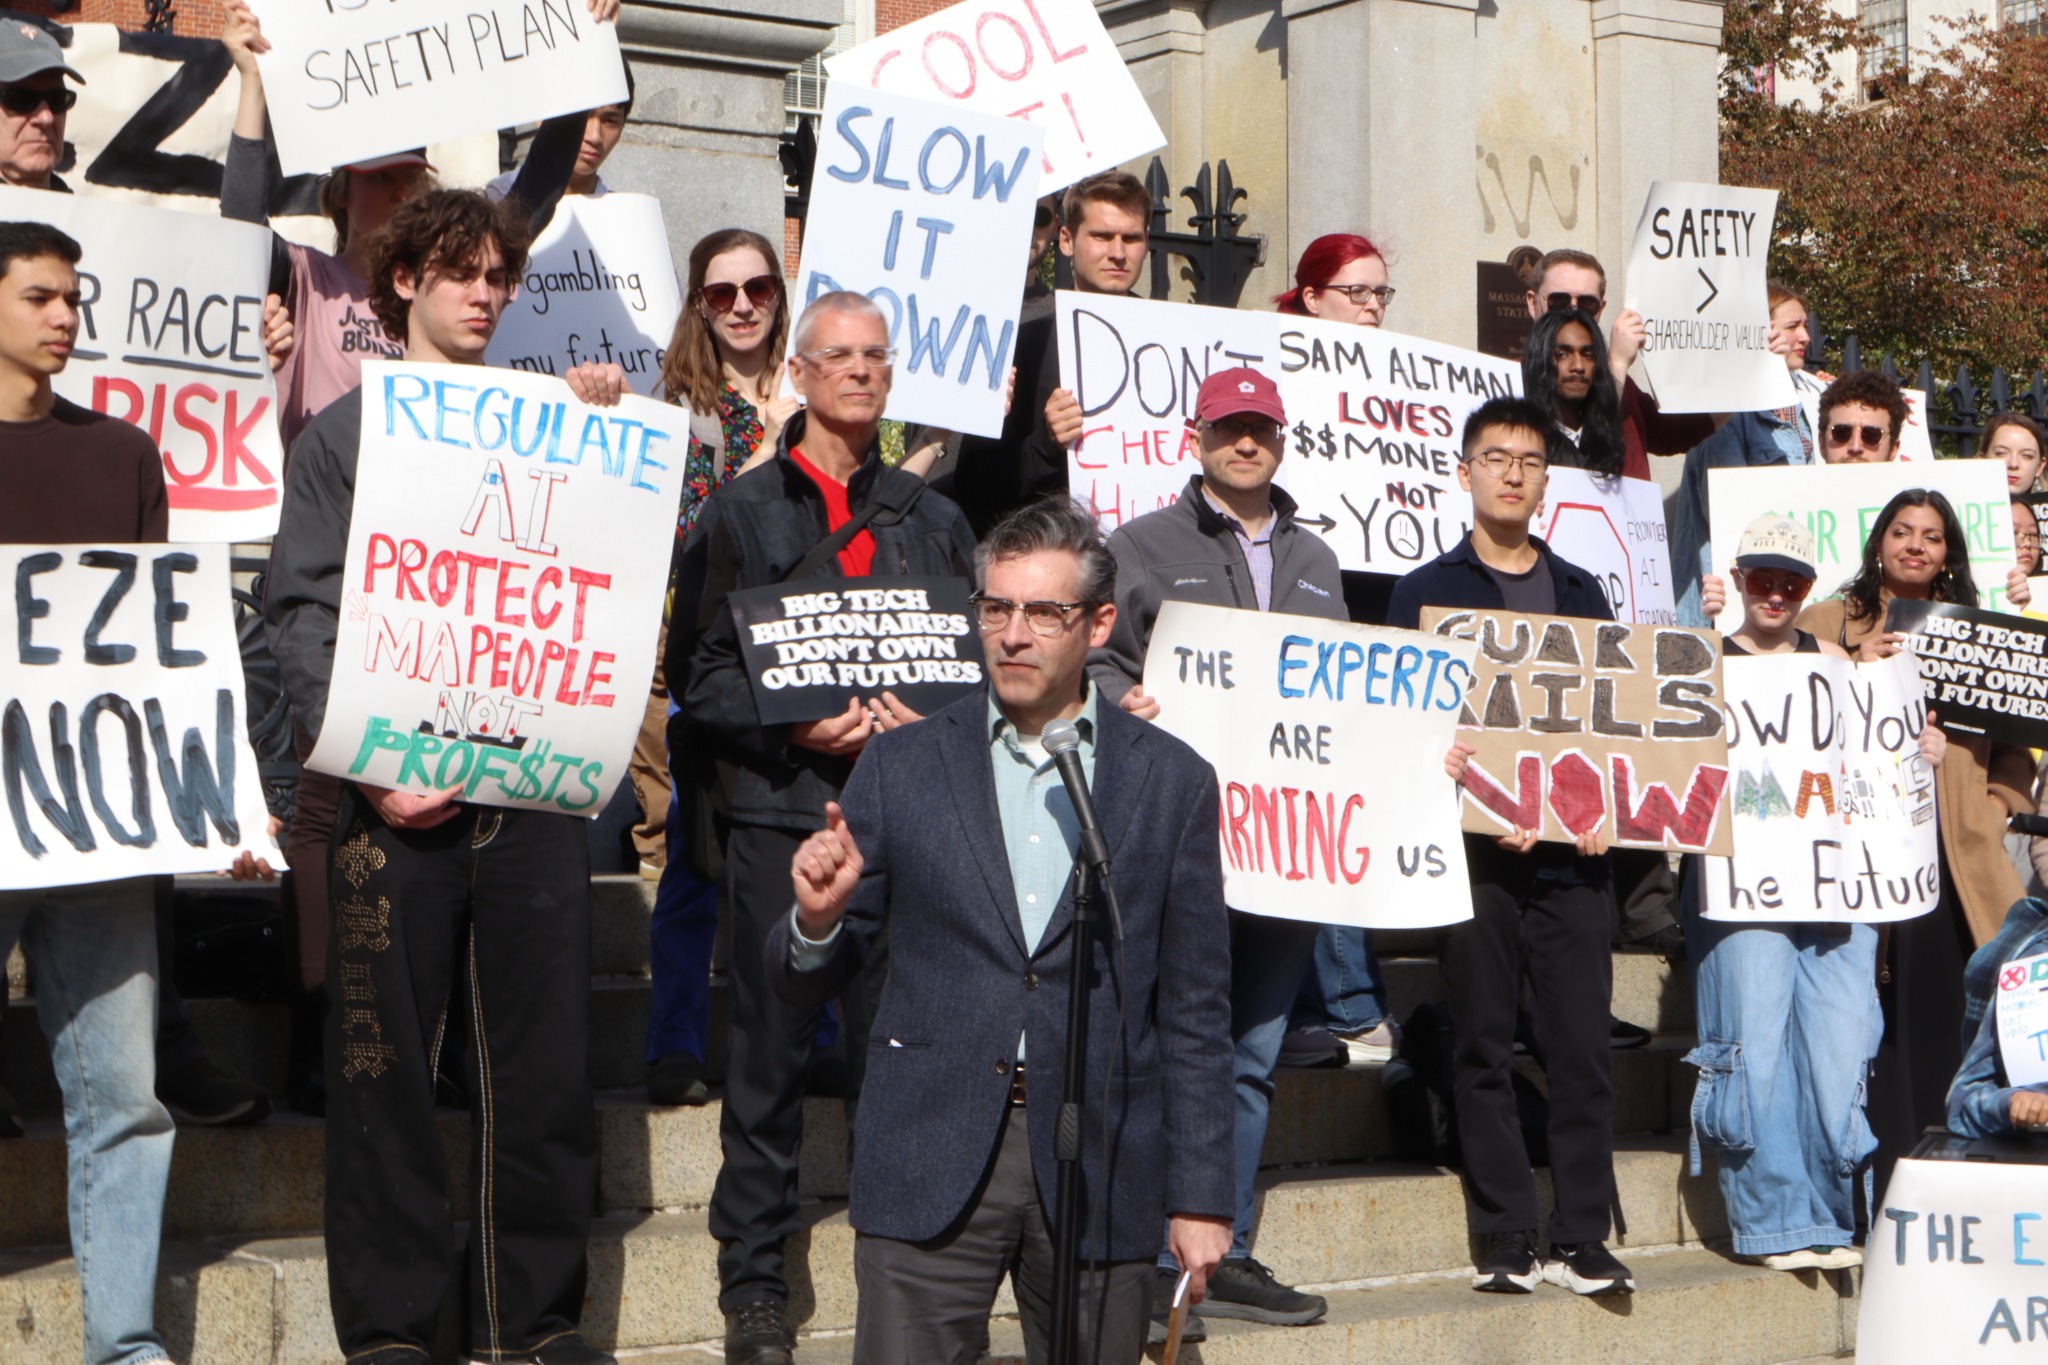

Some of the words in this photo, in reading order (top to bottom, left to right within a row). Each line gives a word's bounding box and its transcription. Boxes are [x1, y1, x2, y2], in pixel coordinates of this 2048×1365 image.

[305, 23, 456, 110] SAFETY
[467, 0, 580, 71] PLAN
[827, 105, 1030, 203] SLOW
[883, 210, 956, 280] IT
[1650, 207, 1756, 259] SAFETY
[526, 248, 647, 315] gambling
[127, 277, 262, 362] RACE
[339, 305, 381, 338] JUST
[1644, 318, 1729, 352] SHAREHOLDER
[1735, 324, 1766, 350] VALUE
[510, 354, 556, 376] my
[1280, 331, 1372, 381] SAM
[1390, 346, 1515, 399] ALTMAN
[383, 373, 671, 494] REGULATE
[1338, 391, 1453, 438] LOVES
[460, 458, 567, 557] AI
[1386, 481, 1447, 511] NOT
[1627, 521, 1668, 546] FRONTIER
[1857, 502, 2013, 563] FRE
[364, 533, 612, 643] PROTECT
[1641, 557, 1660, 587] AI
[749, 611, 970, 645] BILLIONAIRES
[780, 591, 843, 618] BIG
[843, 589, 931, 612] TECH
[775, 637, 875, 665] DON'T
[878, 636, 957, 661] OWN
[1925, 615, 1972, 641] BIG
[1975, 623, 2046, 654] TECH
[467, 624, 616, 707] PEOPLE
[761, 662, 837, 690] OUR
[835, 660, 983, 688] FUTURES
[1174, 646, 1236, 690] THE
[1278, 634, 1470, 711] EXPERTS
[1917, 657, 1984, 687] ON'T
[1985, 670, 2048, 699] OWN
[433, 690, 543, 743] NOT
[1269, 722, 1332, 765] ARE
[1849, 679, 1924, 753] You
[2, 688, 240, 861] NOW
[1459, 748, 1730, 850] NOW
[1218, 781, 1371, 886] RNING
[1397, 844, 1447, 878] US
[1812, 839, 1939, 911] Future
[1885, 1207, 1985, 1267] THE
